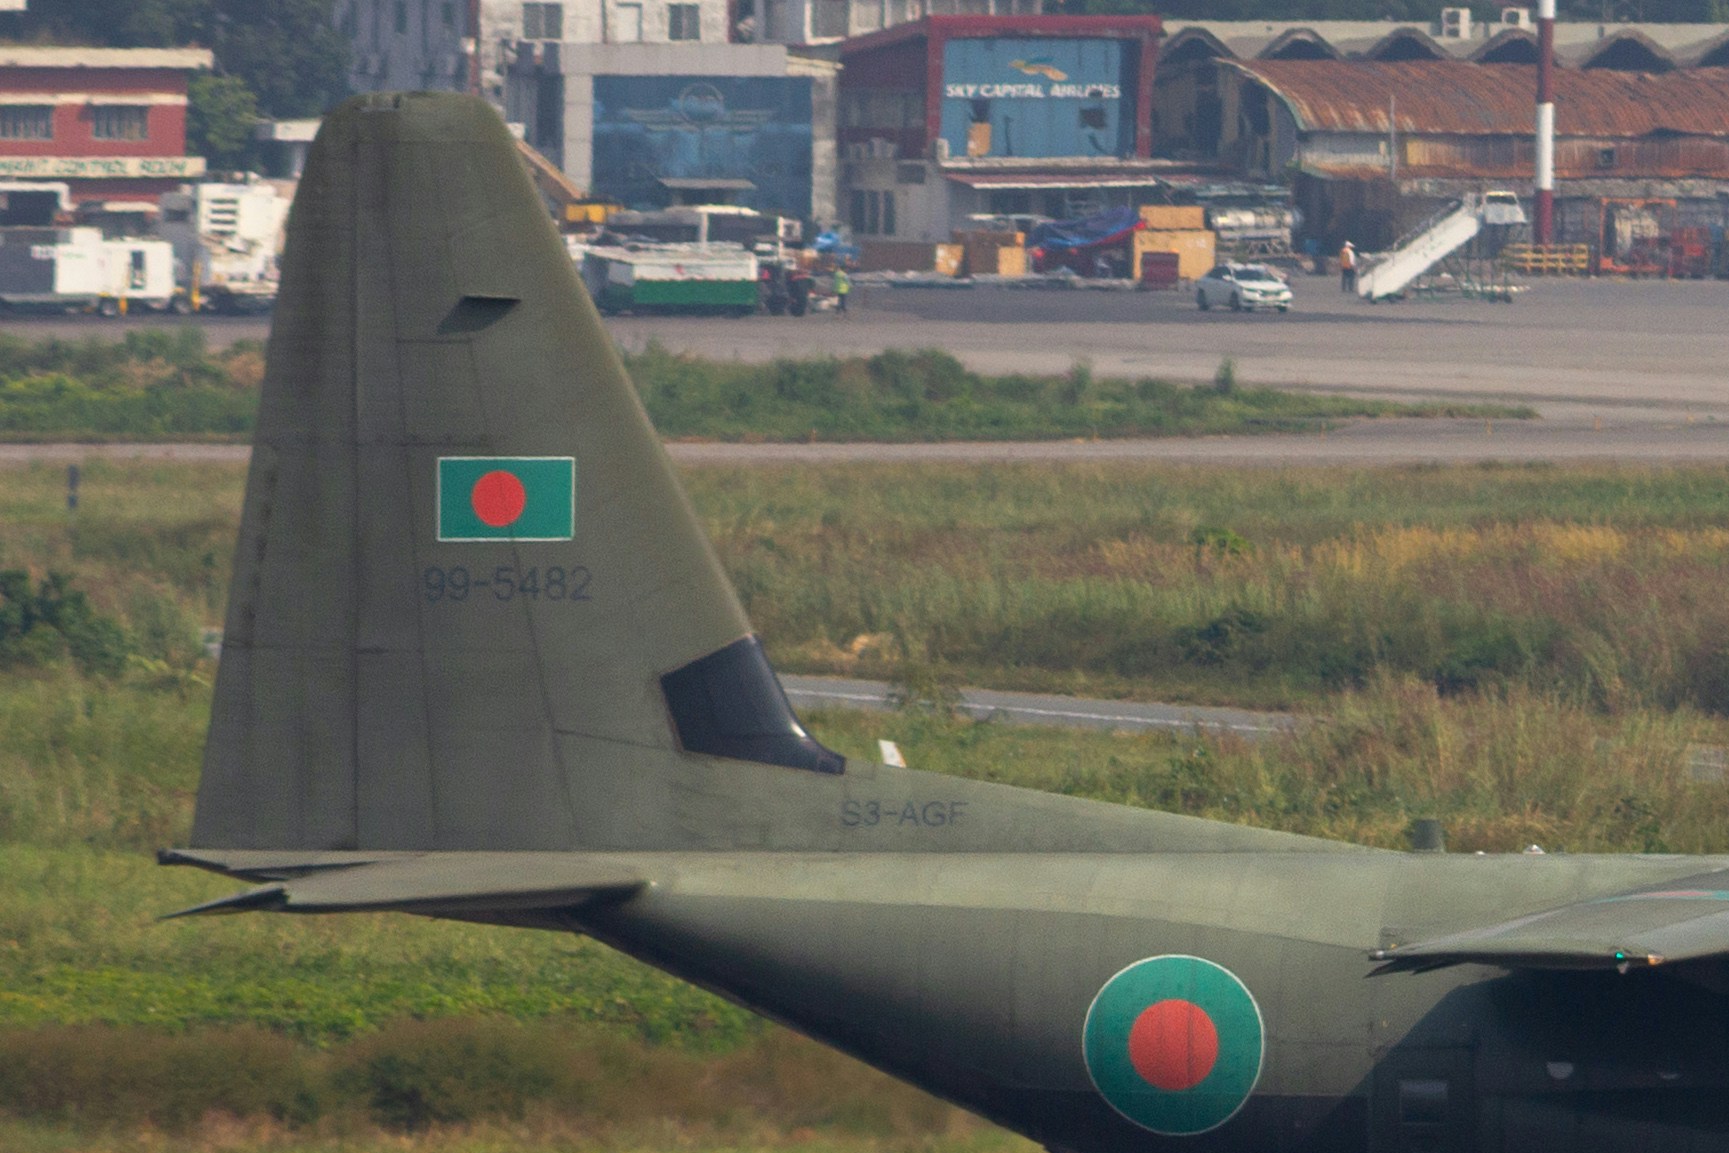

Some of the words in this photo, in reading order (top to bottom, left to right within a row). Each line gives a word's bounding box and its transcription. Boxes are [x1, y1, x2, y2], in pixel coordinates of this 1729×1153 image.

[946, 83, 977, 98] SKY
[979, 83, 1044, 98] CAPITAL
[424, 565, 593, 601] 99-5482
[842, 801, 970, 827] S3-AGF
